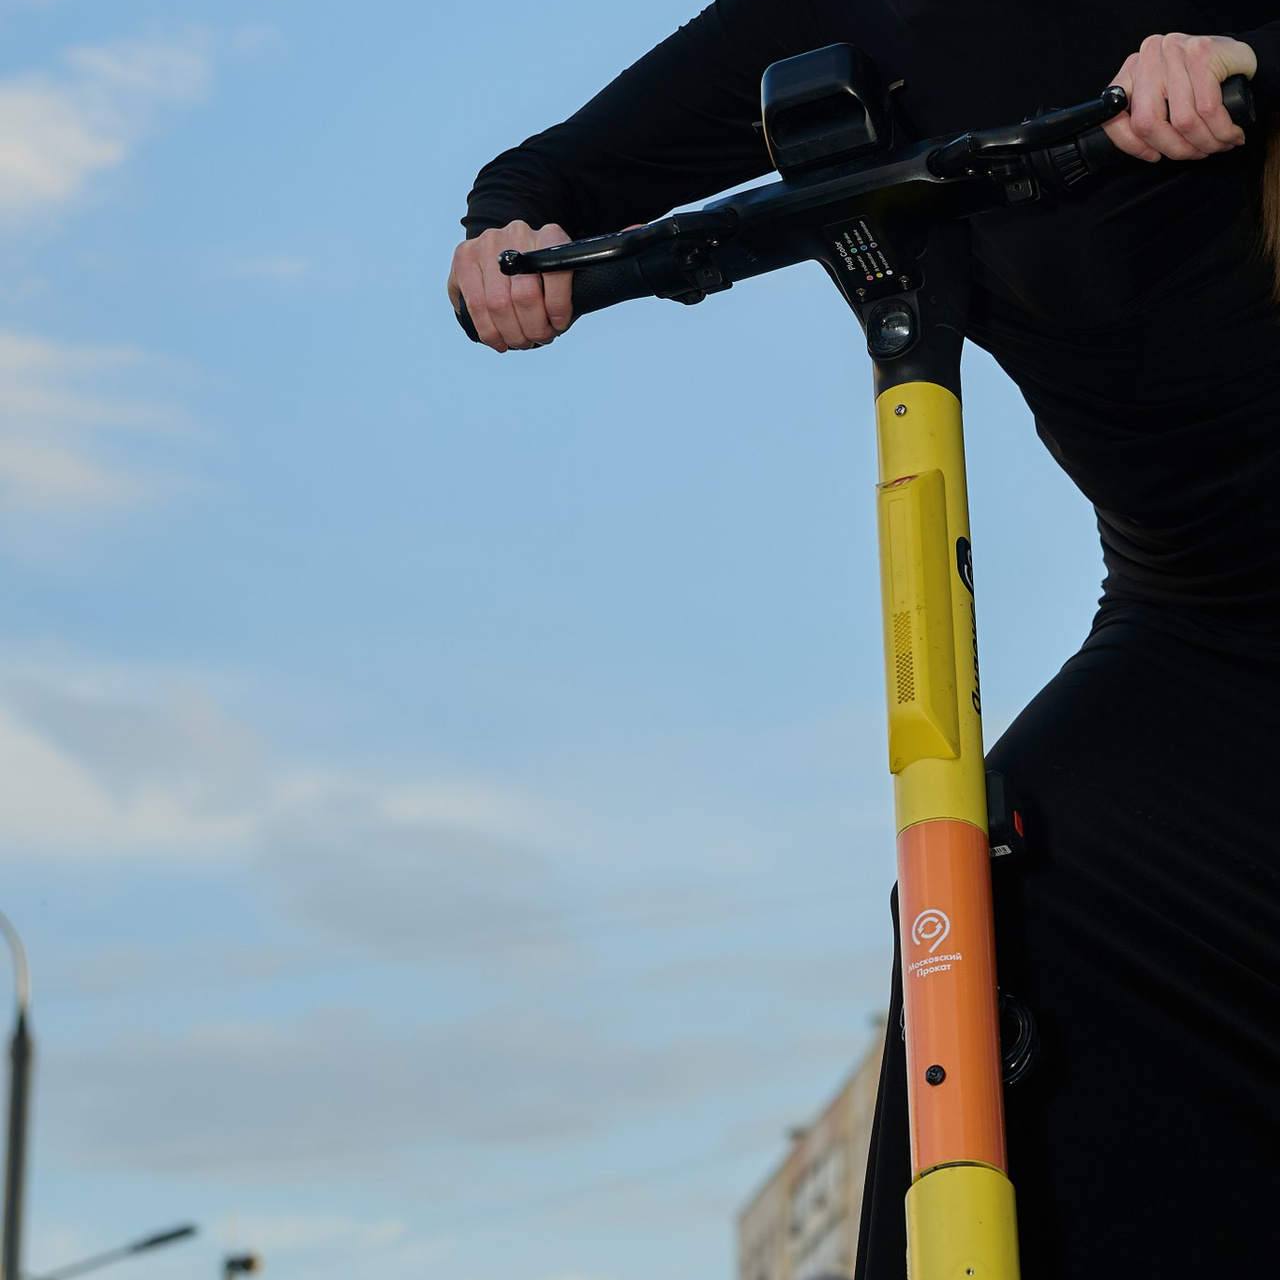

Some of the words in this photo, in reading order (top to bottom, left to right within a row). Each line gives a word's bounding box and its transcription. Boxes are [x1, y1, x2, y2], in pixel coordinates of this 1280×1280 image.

[834, 241, 848, 257] Color
[844, 256, 856, 271] Plug
[908, 952, 962, 974] Московский
[916, 964, 951, 978] Прокат
